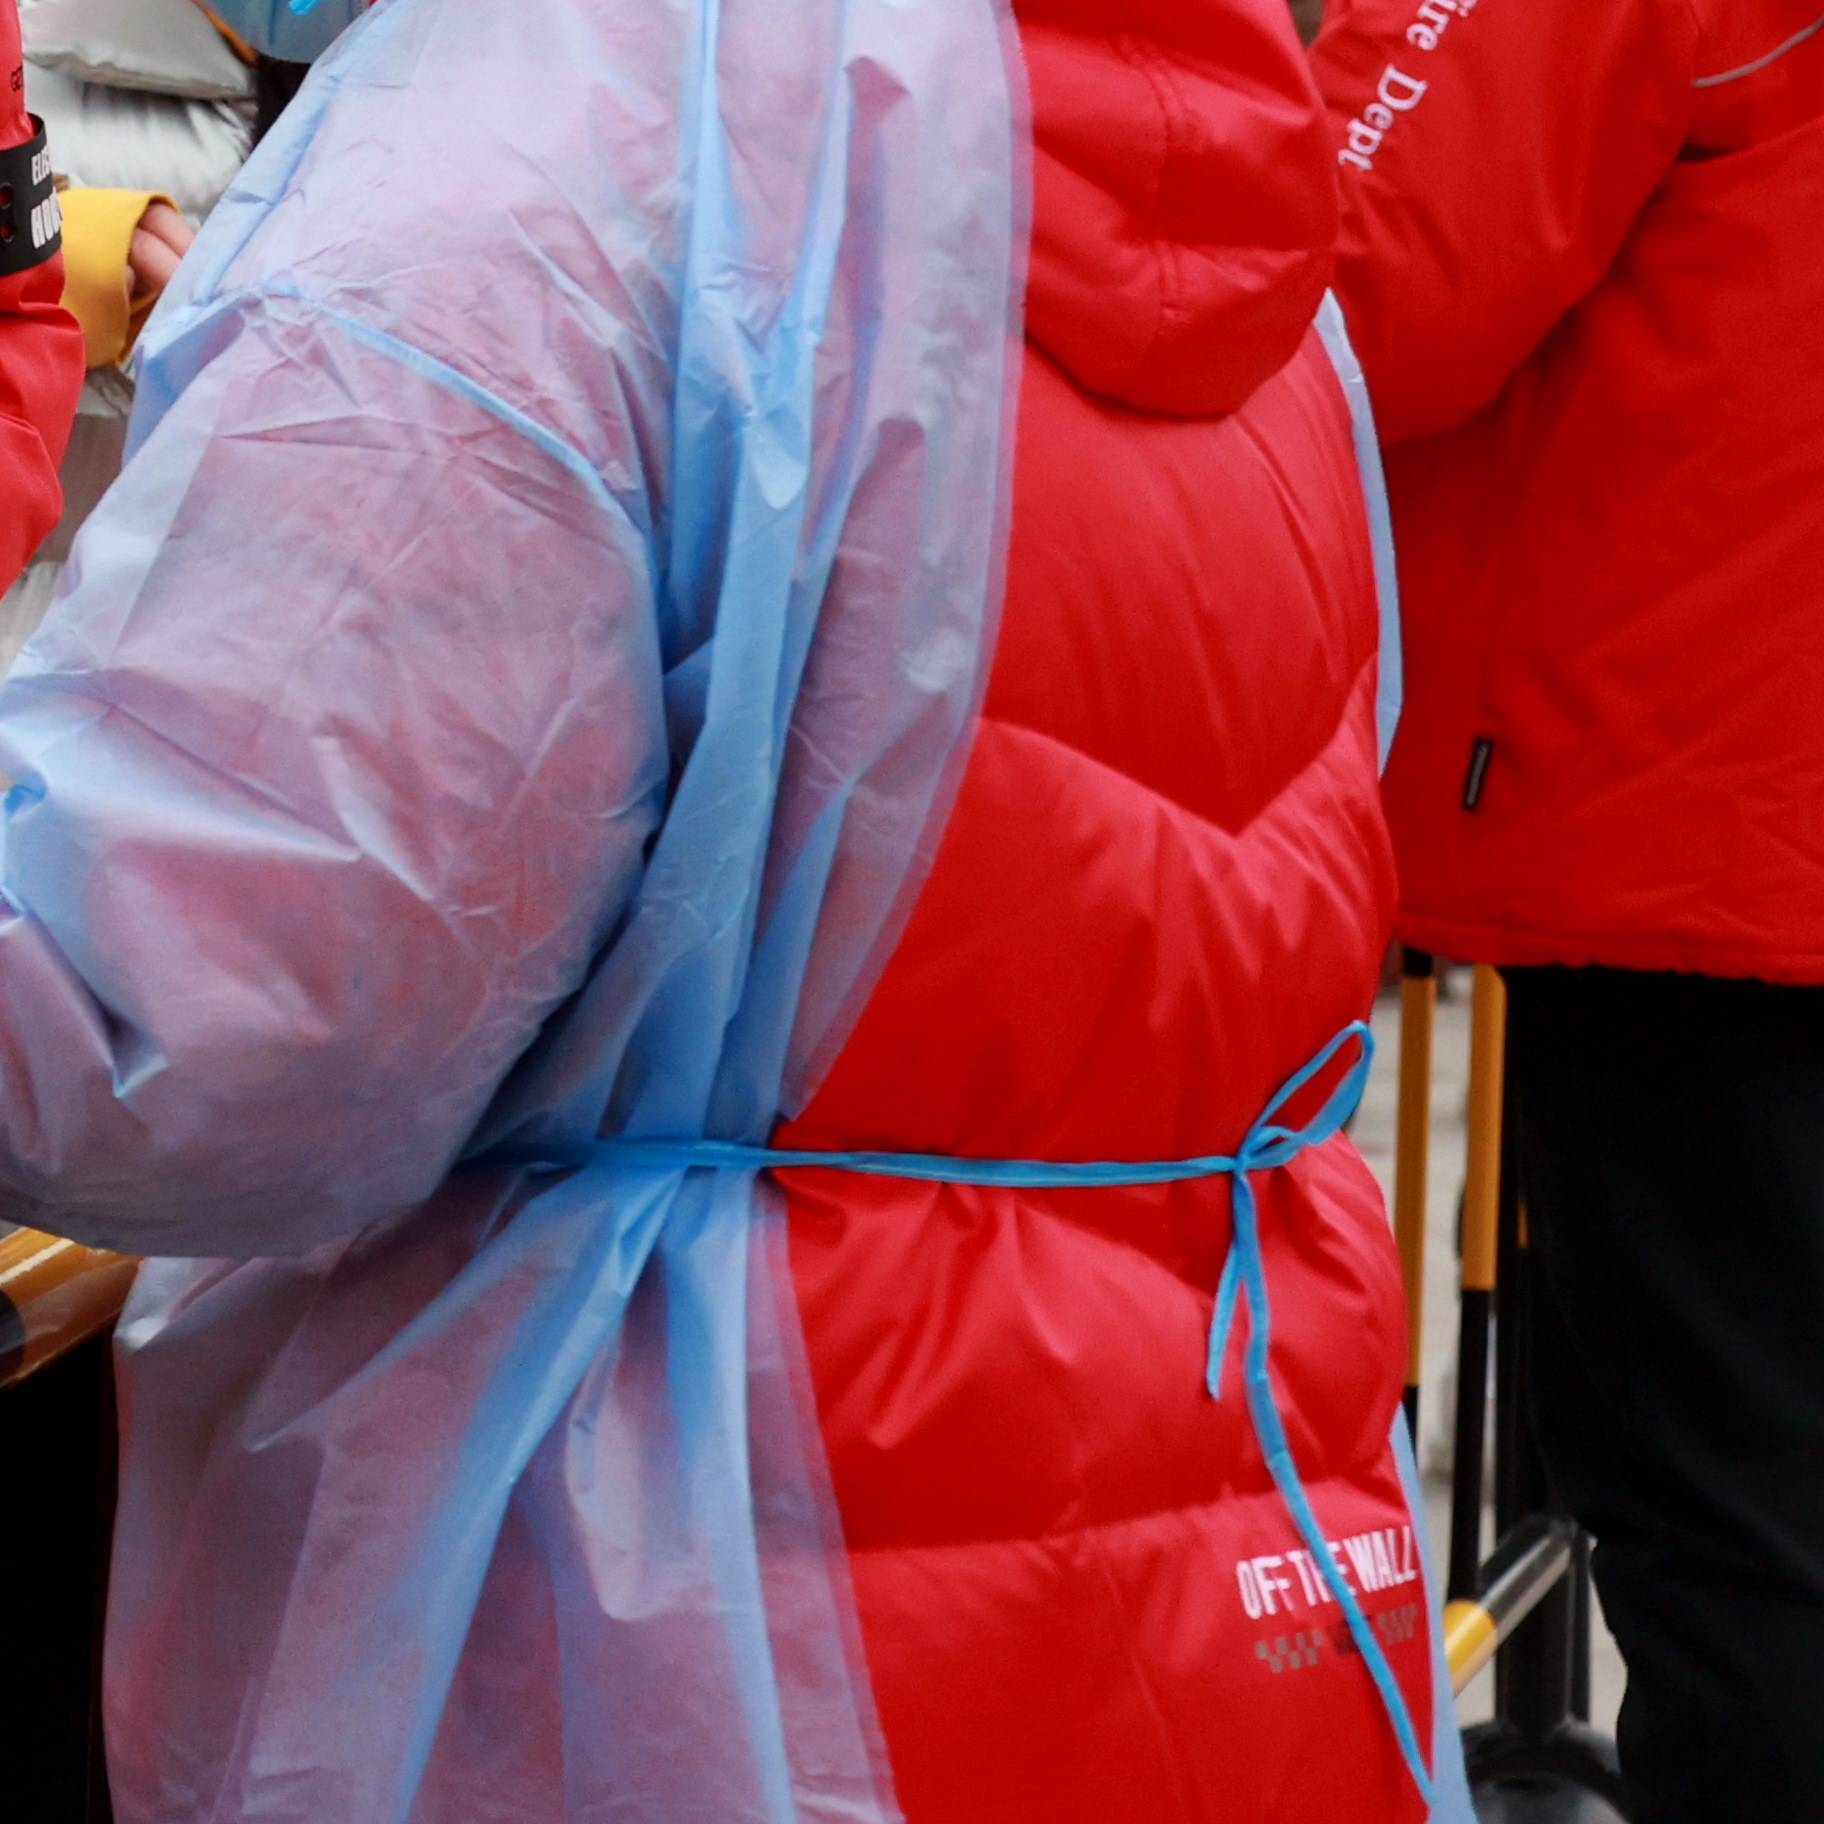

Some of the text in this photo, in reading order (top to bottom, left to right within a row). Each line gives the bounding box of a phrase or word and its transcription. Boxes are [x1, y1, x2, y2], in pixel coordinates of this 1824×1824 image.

[1337, 63, 1429, 172] Dept
[1236, 1554, 1295, 1620] OFF
[1342, 1524, 1417, 1593] WALL
